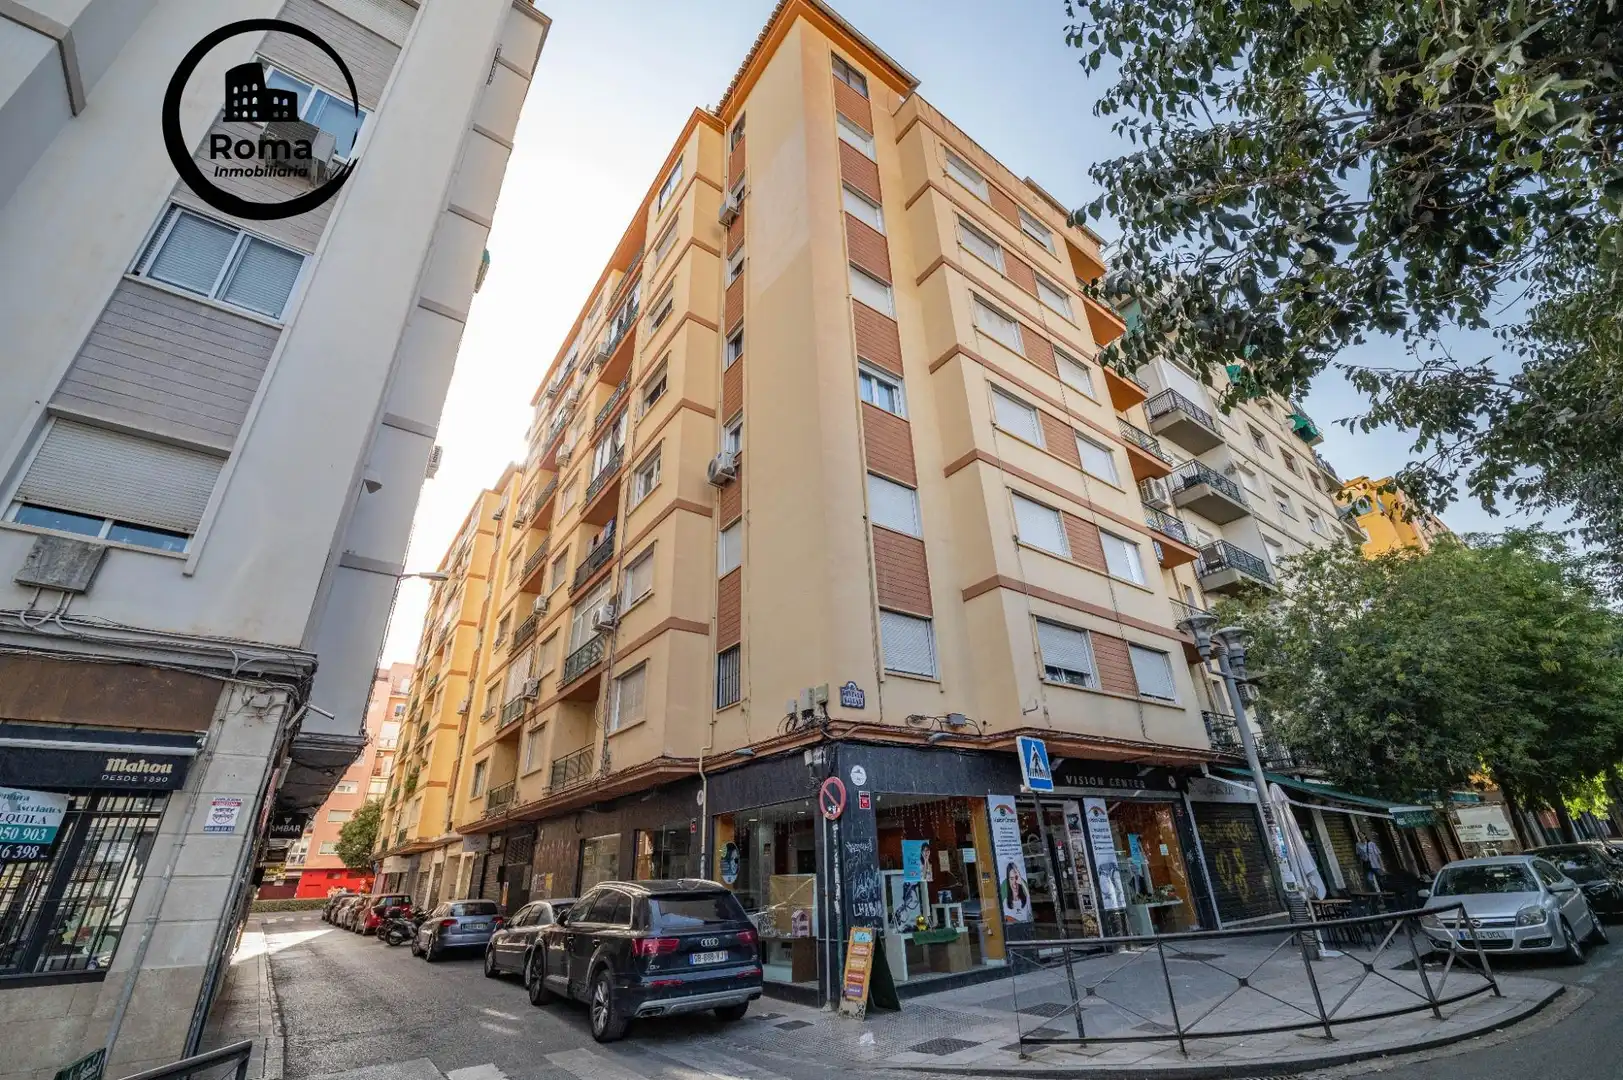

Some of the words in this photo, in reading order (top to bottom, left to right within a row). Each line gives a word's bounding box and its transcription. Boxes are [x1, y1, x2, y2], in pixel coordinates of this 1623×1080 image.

[105, 758, 173, 774] Mahou
[1065, 775, 1104, 786] VISION
[1109, 778, 1146, 789] CENTER
[22, 828, 48, 841] 903
[12, 845, 40, 859] 398
